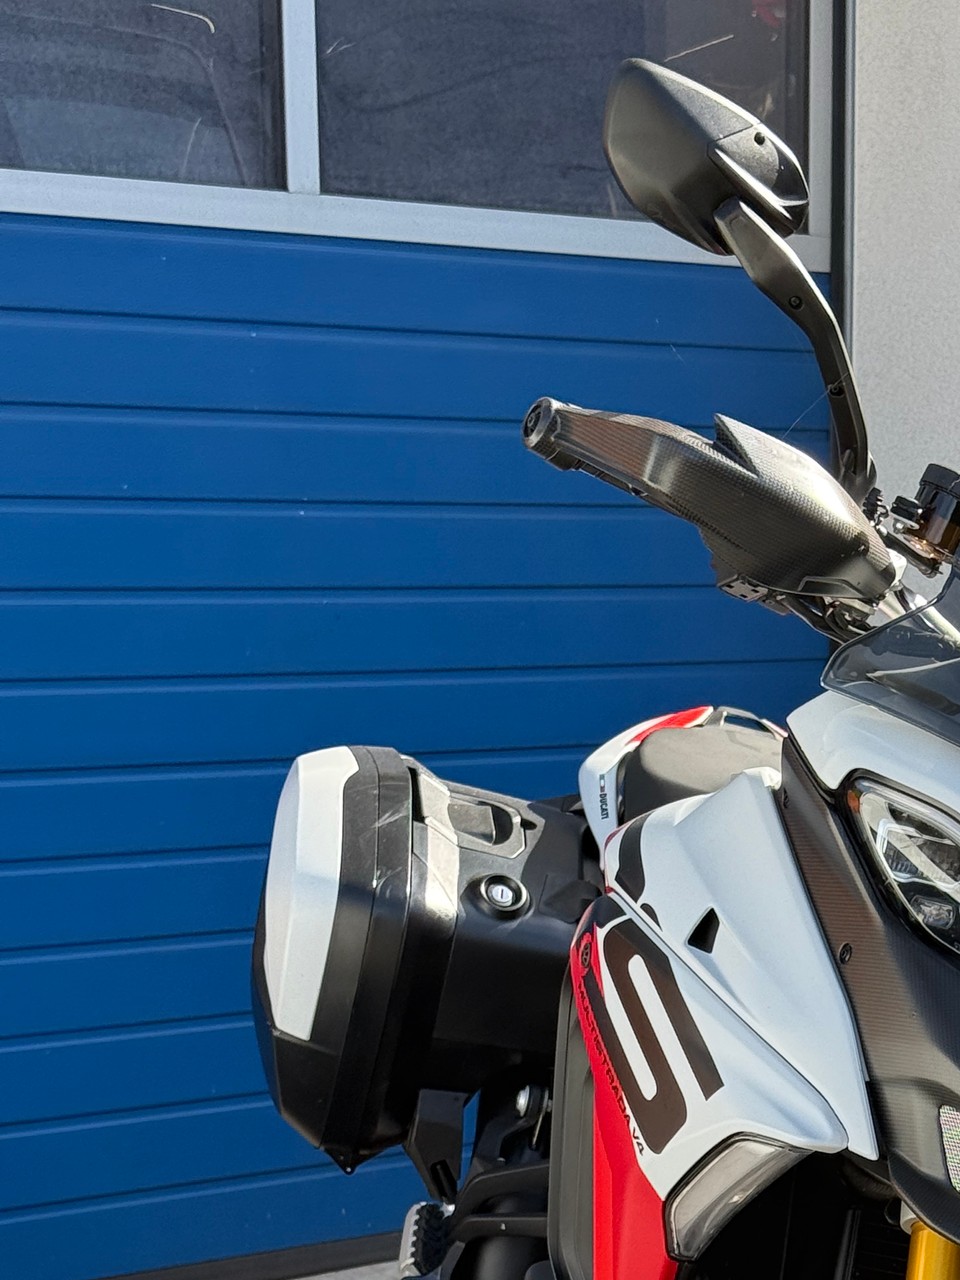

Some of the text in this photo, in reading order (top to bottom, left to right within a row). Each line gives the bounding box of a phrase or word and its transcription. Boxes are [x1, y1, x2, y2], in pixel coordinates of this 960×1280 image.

[599, 793, 610, 820] DUCATI
[577, 981, 645, 1156] MULTISTRADA V4
